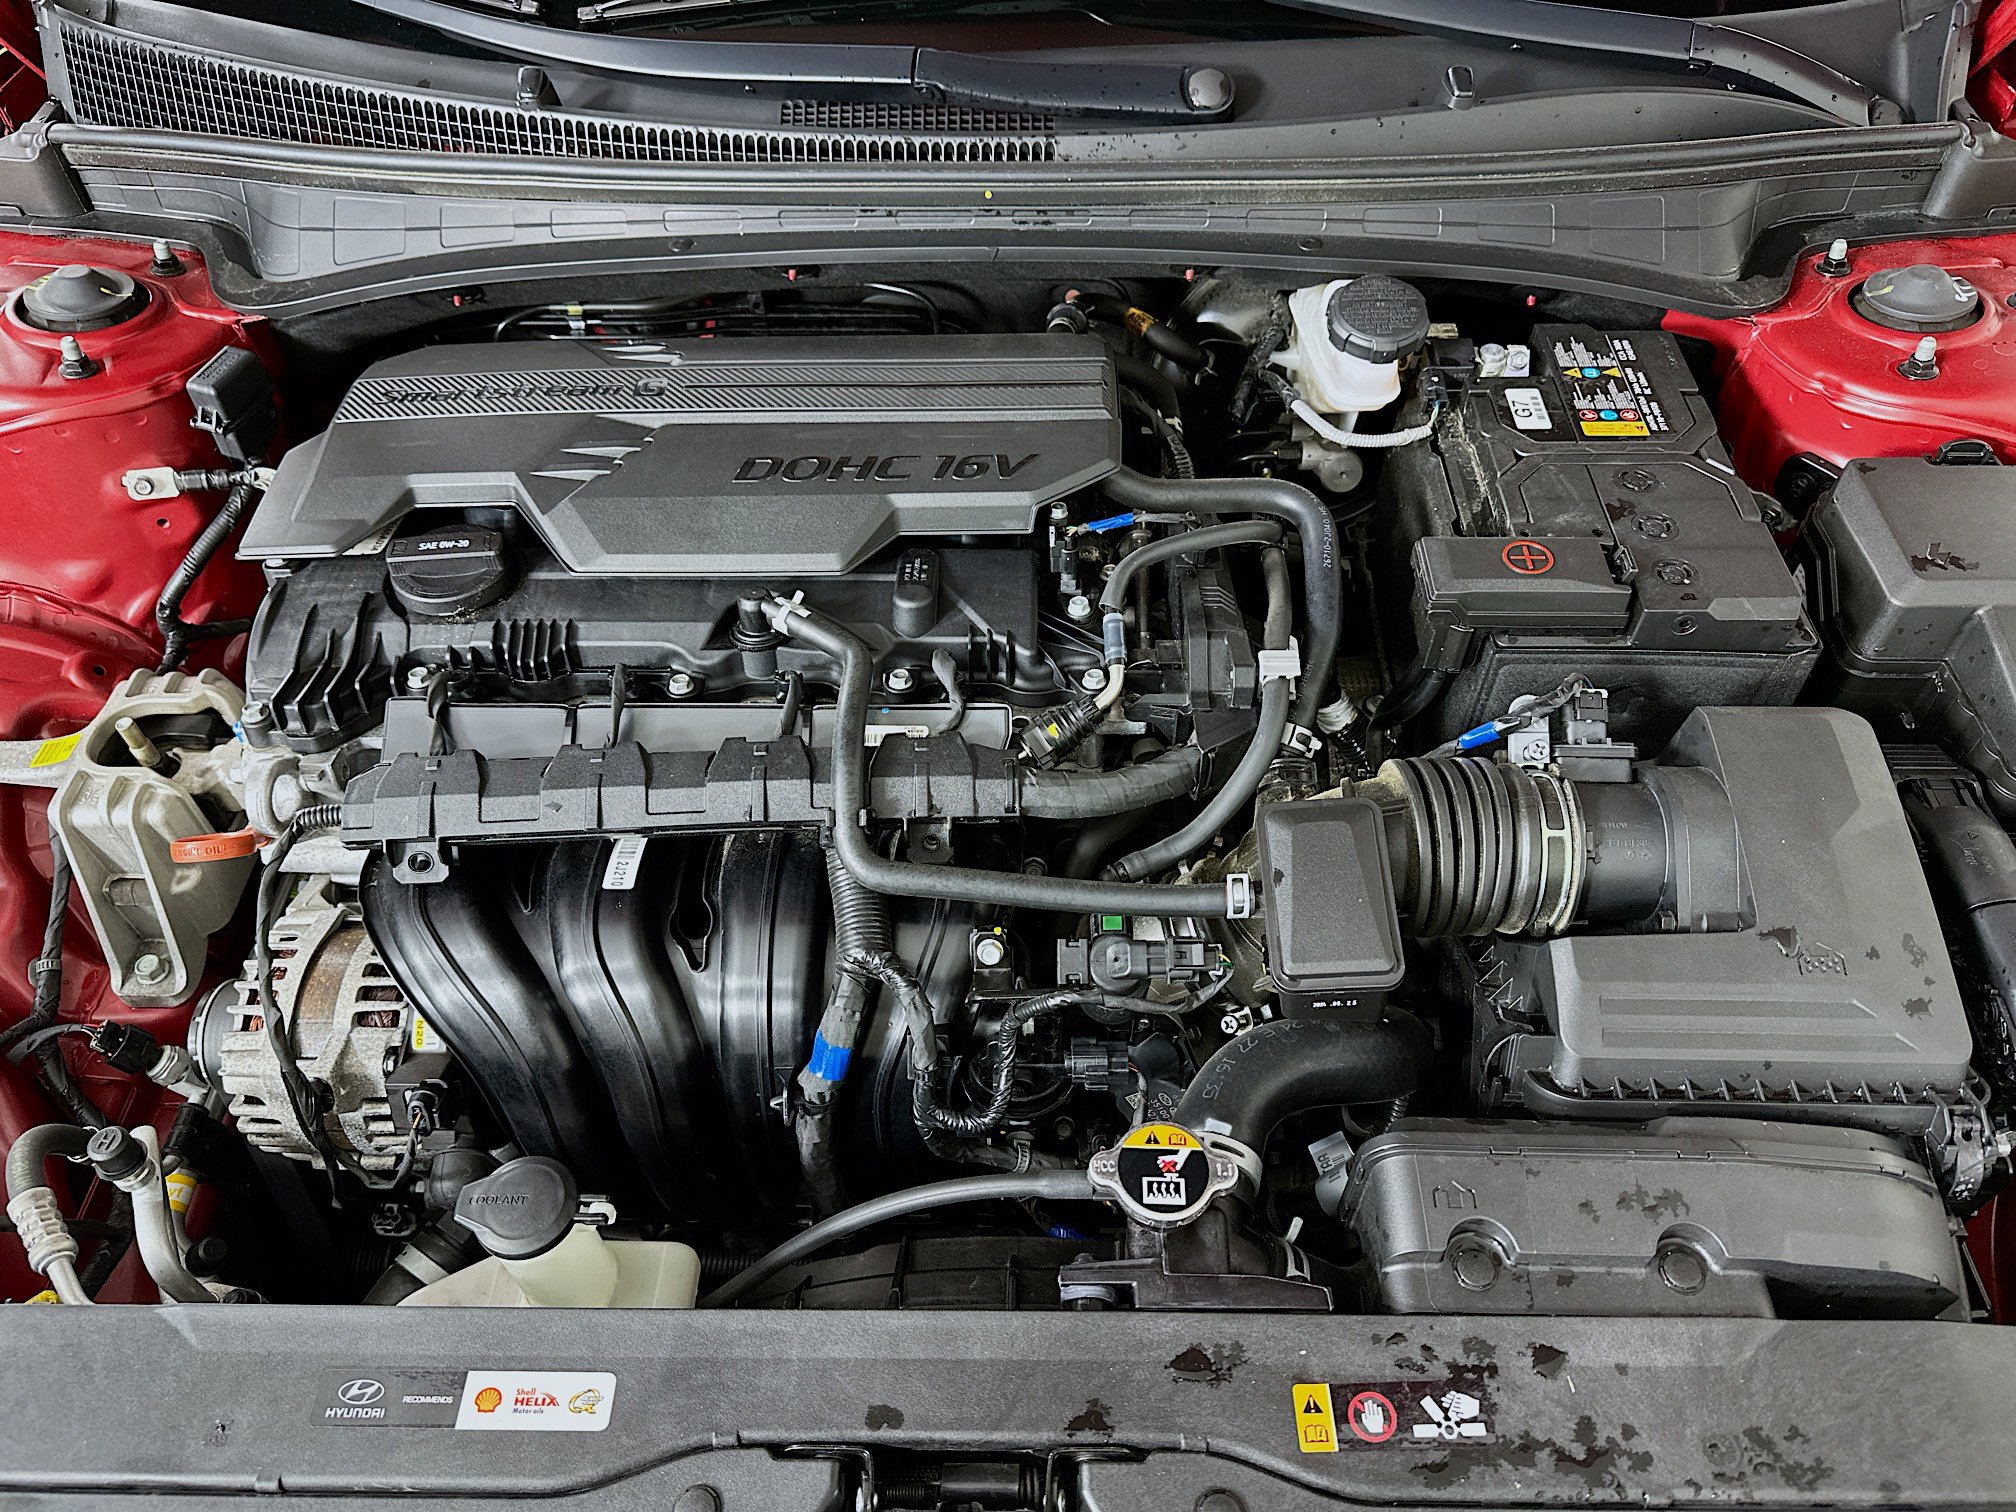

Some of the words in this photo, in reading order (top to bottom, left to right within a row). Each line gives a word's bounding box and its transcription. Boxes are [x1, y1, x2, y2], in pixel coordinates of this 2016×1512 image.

[1127, 312, 1146, 327] A02
[373, 383, 624, 405] Smartstream
[1514, 399, 1534, 419] G7
[732, 454, 921, 483] DOHC
[931, 453, 1040, 481] 16V
[417, 541, 438, 551] SAE
[438, 539, 470, 549] 0W-20
[1322, 518, 1332, 568] 26710-2J040
[611, 862, 629, 887] 2J210
[416, 1020, 424, 1045] N20
[1092, 1160, 1116, 1172] HCC
[1216, 1163, 1233, 1176] 1.1
[469, 1195, 530, 1205] COOLANT
[515, 1387, 537, 1396] Shell
[402, 1395, 454, 1404] RECOMMENDS
[514, 1396, 560, 1406] HELIX
[325, 1407, 386, 1419] HYUNDAI
